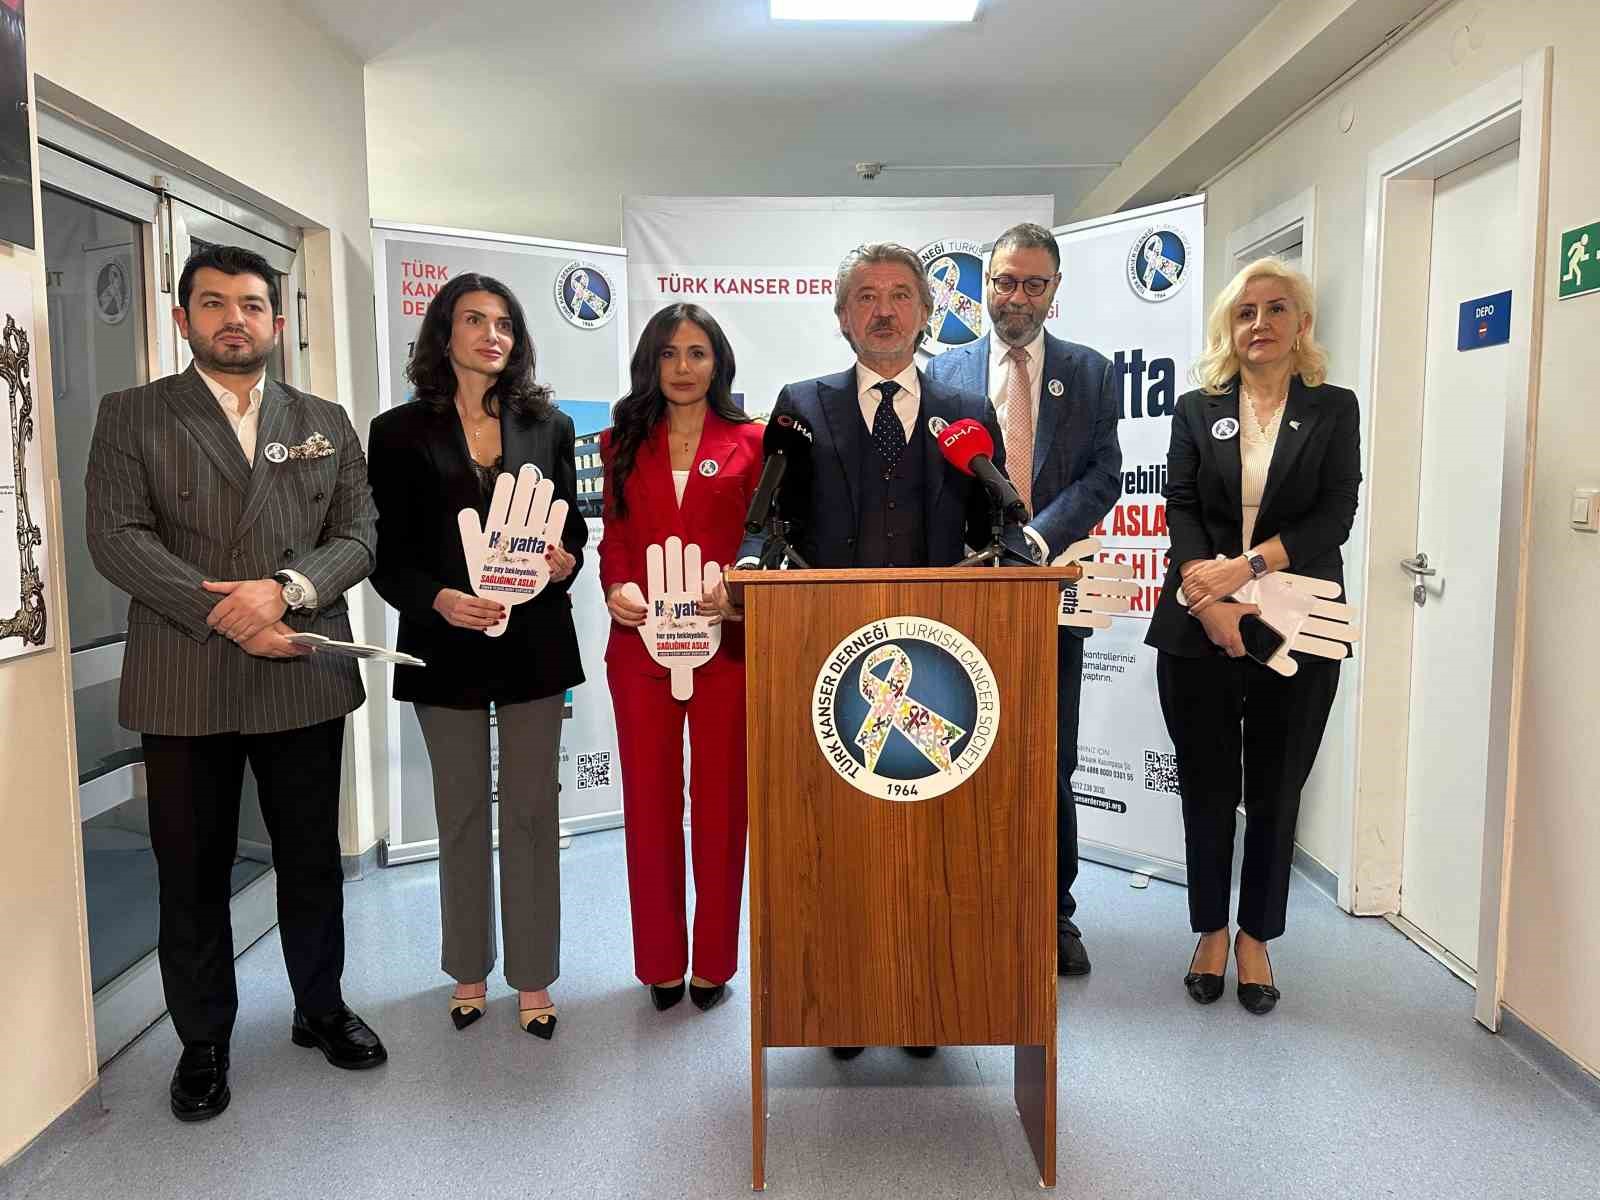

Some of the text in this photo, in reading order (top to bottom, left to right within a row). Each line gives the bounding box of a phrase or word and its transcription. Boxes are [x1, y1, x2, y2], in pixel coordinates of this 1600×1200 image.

[401, 259, 449, 280] TÜRK
[656, 273, 839, 295] TÜRK KANSER DER
[1475, 304, 1495, 318] DEPO
[944, 425, 980, 447] DHA
[1120, 465, 1167, 494] ebili
[818, 622, 993, 779] TÜRK KANSER DERNEĞİ TURKISH CANCER SOCIETY
[887, 783, 919, 796] 1964
